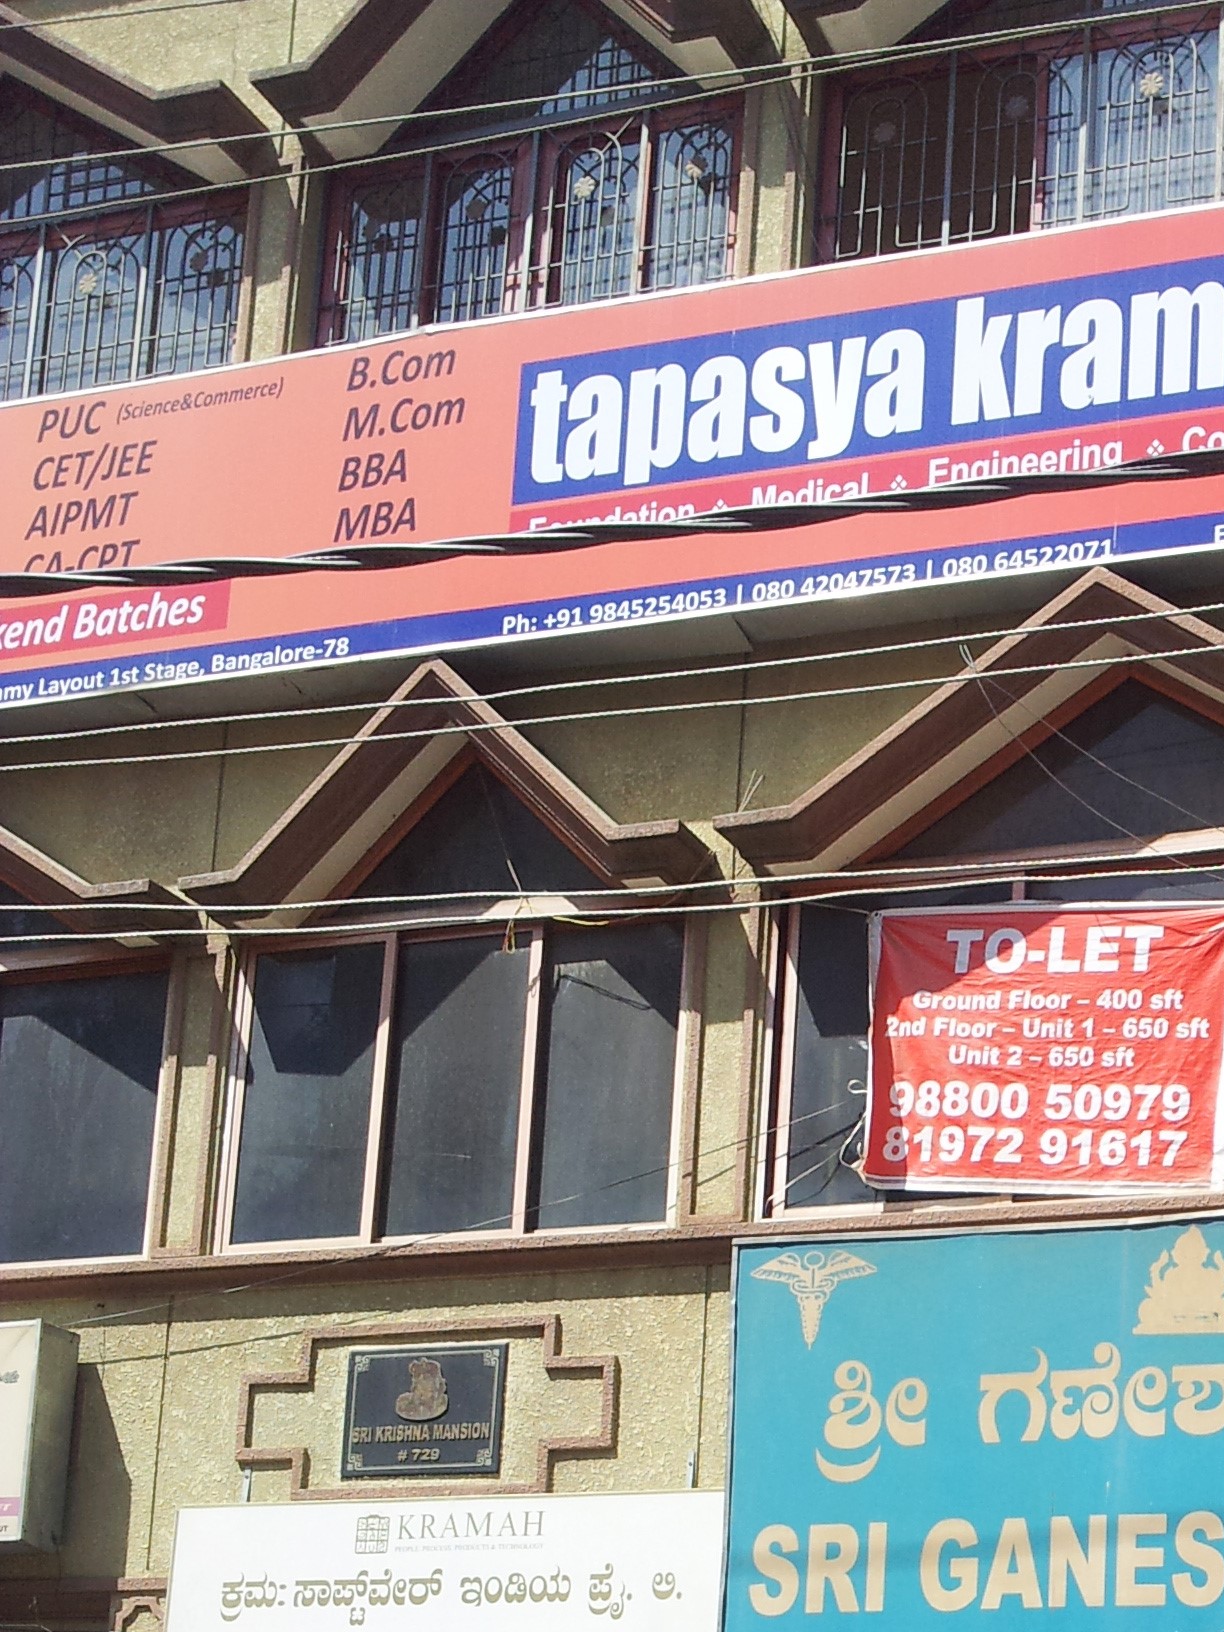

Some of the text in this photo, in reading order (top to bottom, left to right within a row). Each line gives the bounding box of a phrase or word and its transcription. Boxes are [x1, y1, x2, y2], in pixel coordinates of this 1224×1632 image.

[347, 348, 456, 392] B.Com
[37, 377, 285, 443] PUC (Science&Commerce)
[342, 396, 465, 442] M.Com
[529, 328, 926, 486] tapasya
[33, 440, 157, 491] CET/JEE
[337, 448, 407, 492] BBA
[928, 439, 1123, 487] Engineering
[25, 491, 138, 540] AIPMT
[332, 499, 417, 542] MBA
[502, 537, 1114, 635] Ph: +91 9845254053 080 42047573 080 64522071
[73, 592, 206, 640] Batches
[38, 637, 350, 698] Layout 1st Stage, Bangalore-78
[946, 925, 1164, 974] TO-LET
[912, 988, 1184, 1011] Ground Floor 400 sft
[886, 1016, 1210, 1038] 2nd Floor Unit 1 650 sft
[948, 1046, 1135, 1068] Unit 2 650 sft
[889, 1081, 1192, 1122] 98800 50979
[882, 1126, 1189, 1167] 81972 91617
[352, 1422, 490, 1444] SRI KRISHNA MANSION
[812, 1358, 928, 1485] ಶ್ರೀ
[411, 1448, 440, 1461] 729
[398, 1510, 546, 1540] KRAMAH
[749, 1519, 887, 1617] SRI
